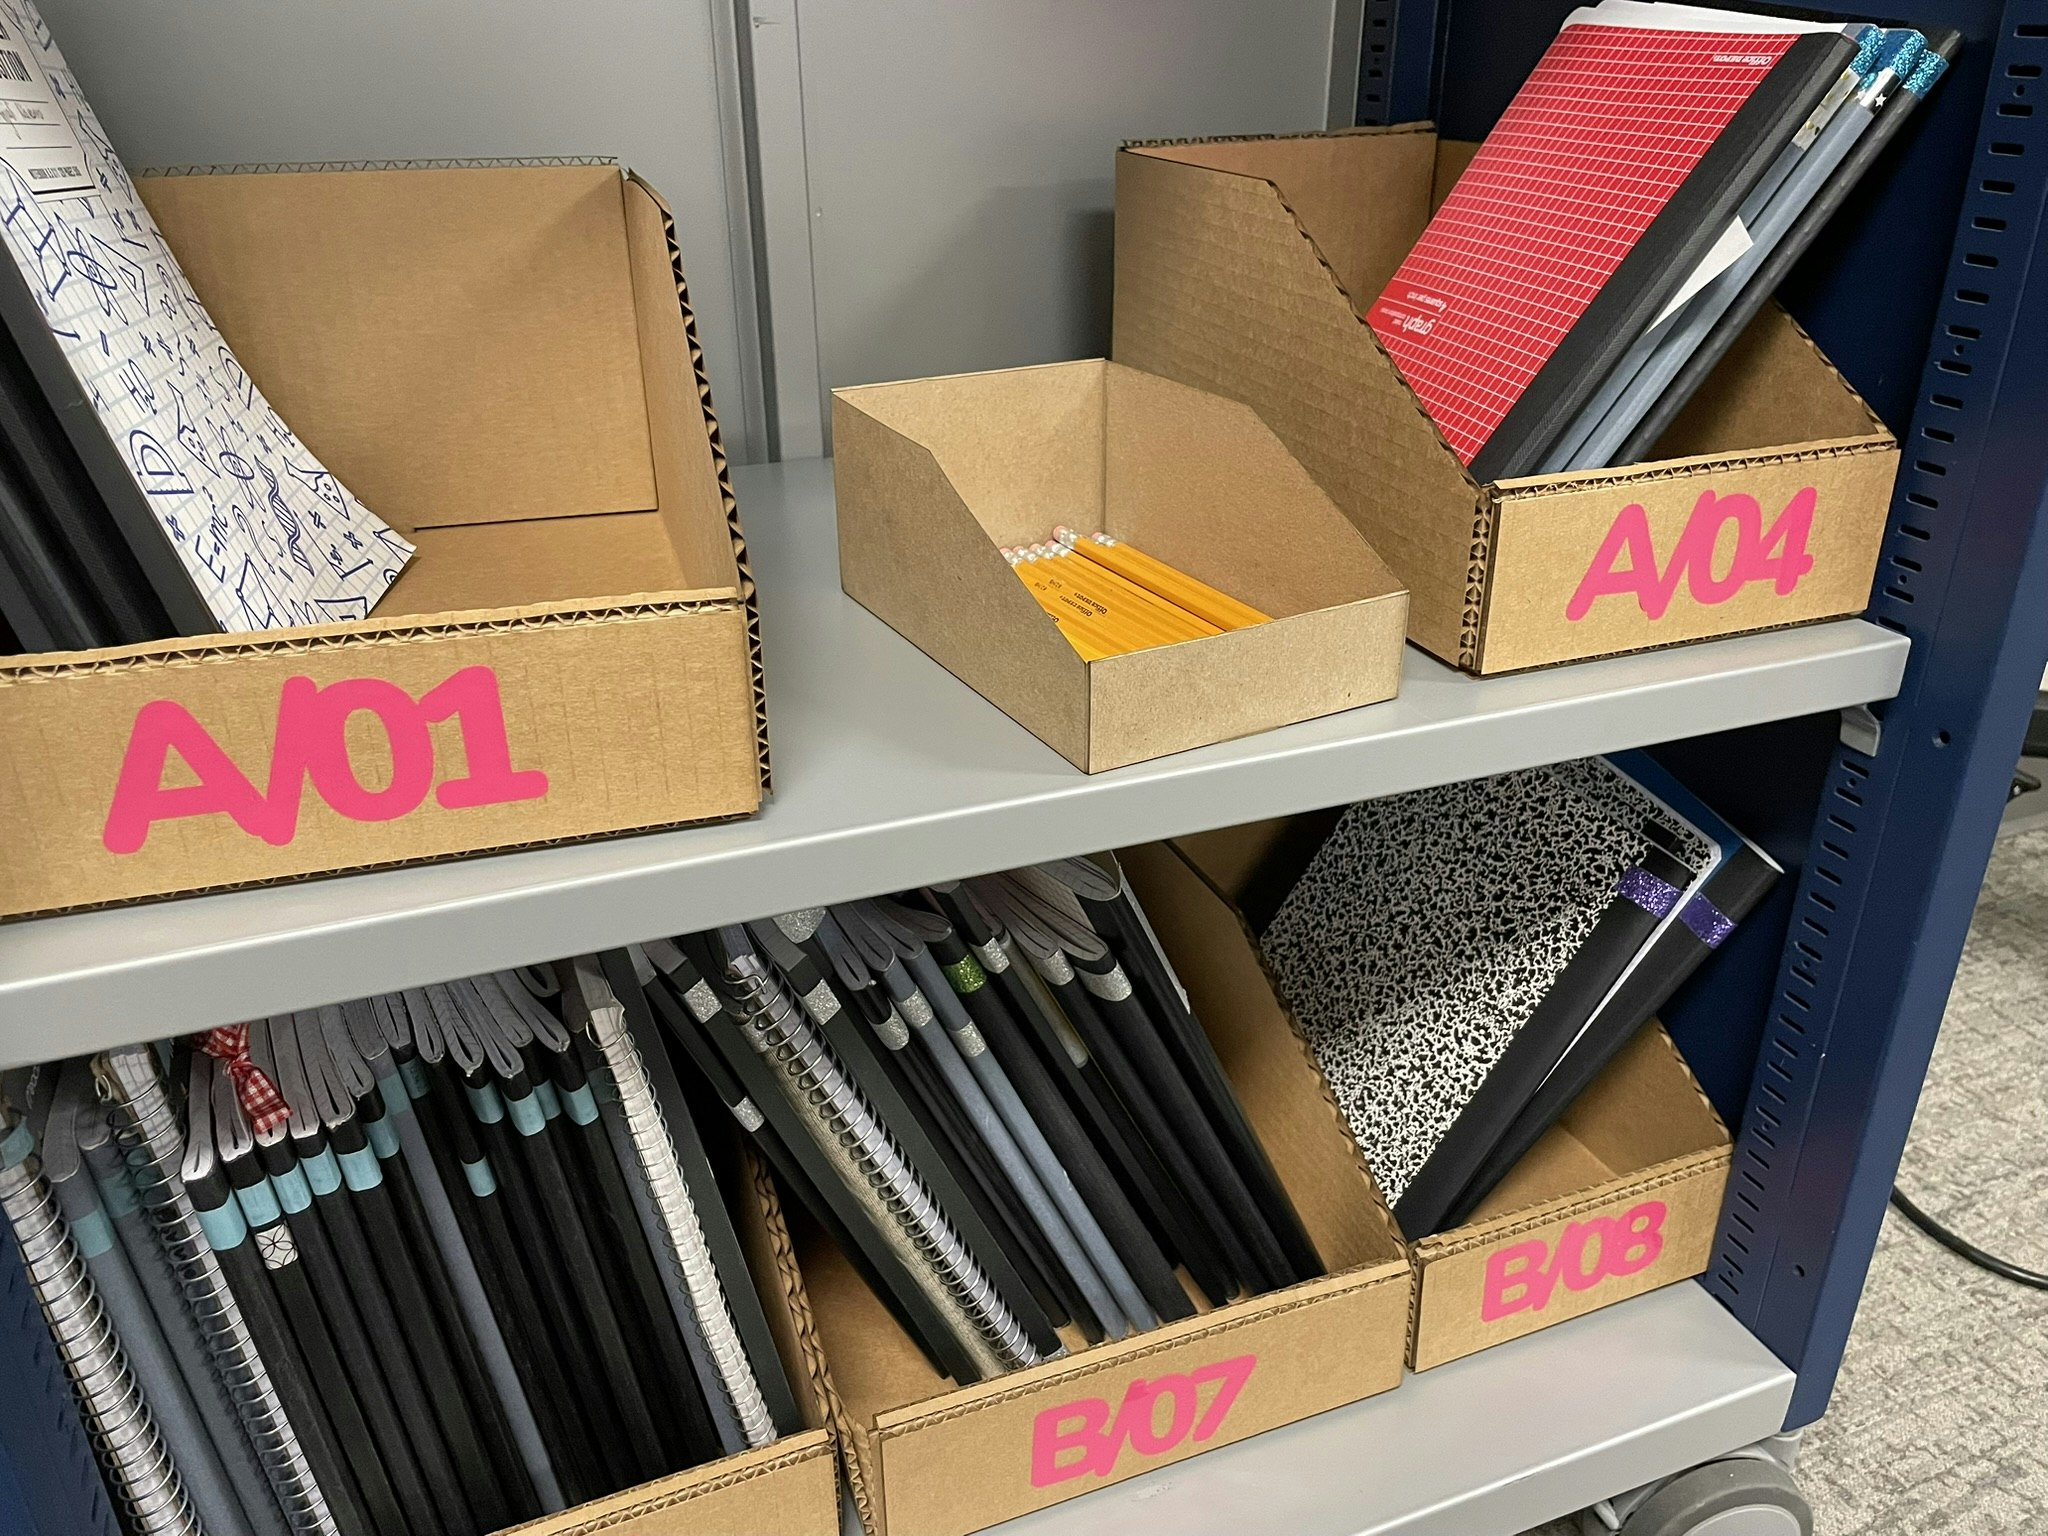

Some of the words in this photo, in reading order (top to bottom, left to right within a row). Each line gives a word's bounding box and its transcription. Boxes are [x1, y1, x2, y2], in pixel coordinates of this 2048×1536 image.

[1402, 314, 1437, 336] graph
[1566, 487, 1817, 622] A/04
[102, 664, 550, 855] A/01
[1481, 1202, 1668, 1323] B/08
[1032, 1355, 1256, 1489] B/07
